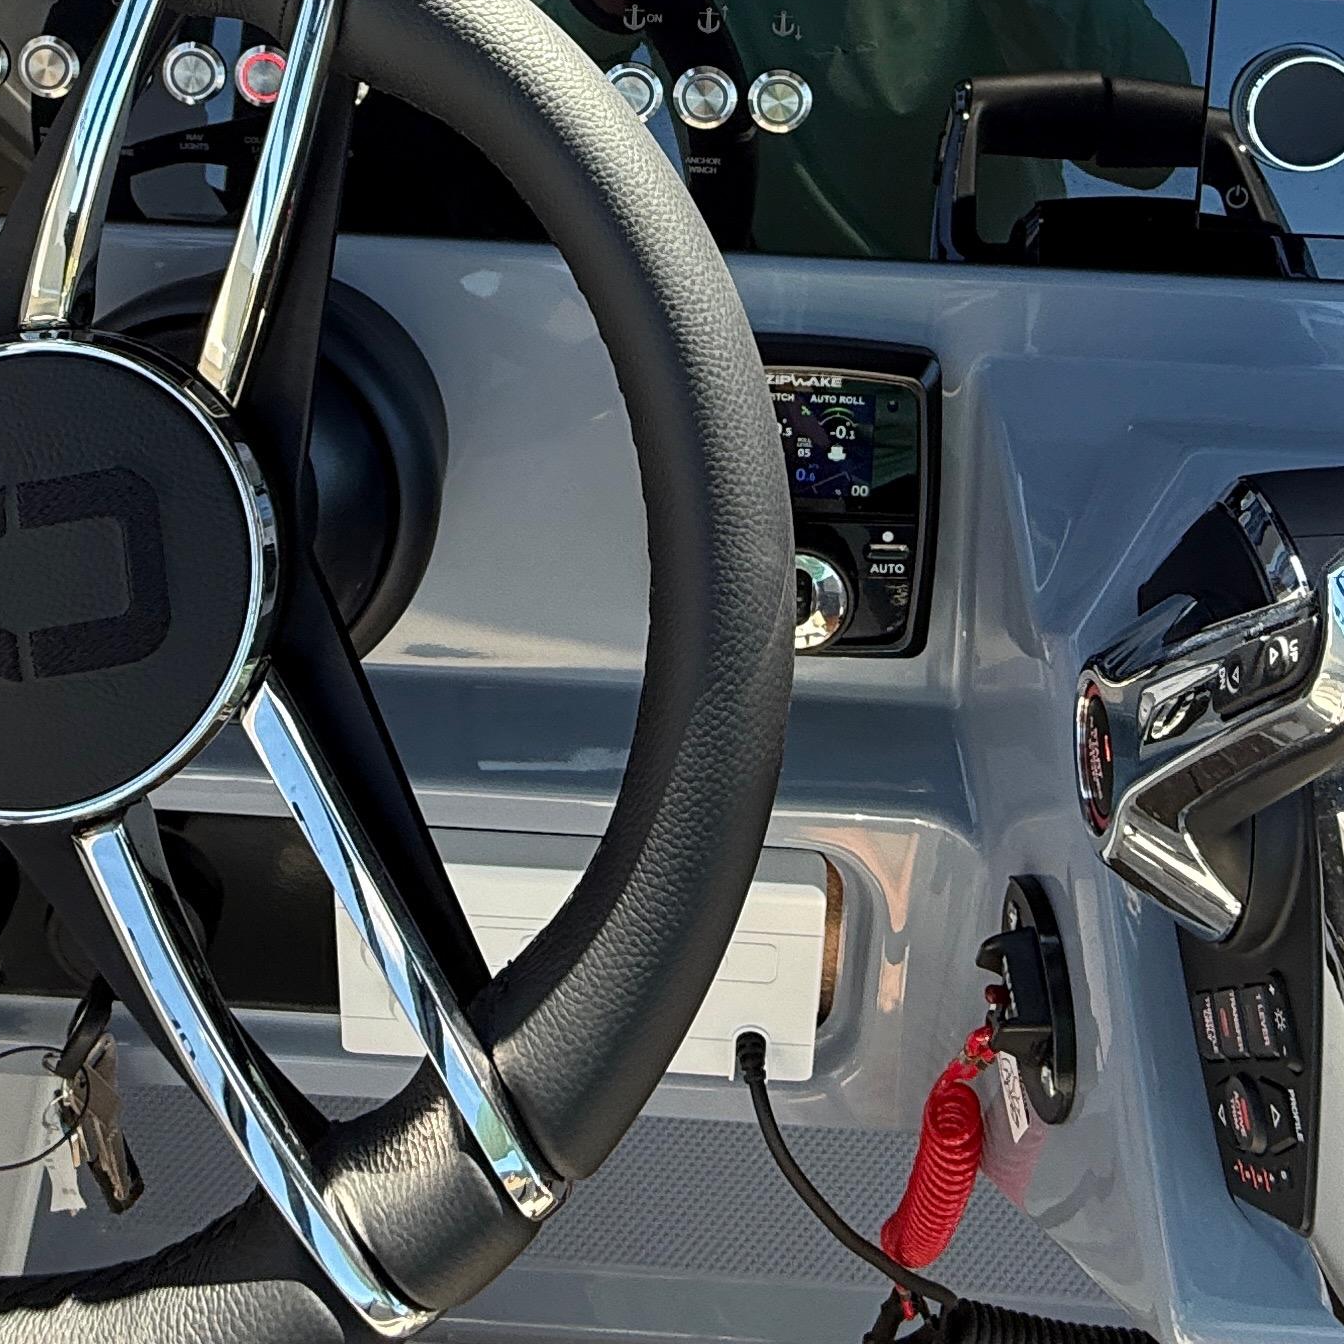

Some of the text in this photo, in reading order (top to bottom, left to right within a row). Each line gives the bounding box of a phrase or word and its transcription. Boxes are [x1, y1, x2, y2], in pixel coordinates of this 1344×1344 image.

[646, 12, 662, 24] ON
[685, 157, 721, 166] ANCHOR
[689, 166, 717, 174] WINCH
[766, 374, 842, 388] ZIPWAKE
[810, 394, 865, 405] AUTO ROLL
[870, 564, 905, 574] AUTO
[1288, 638, 1299, 663] UP
[1258, 1004, 1271, 1047] LEVER
[1287, 1088, 1304, 1143] PROFILE
